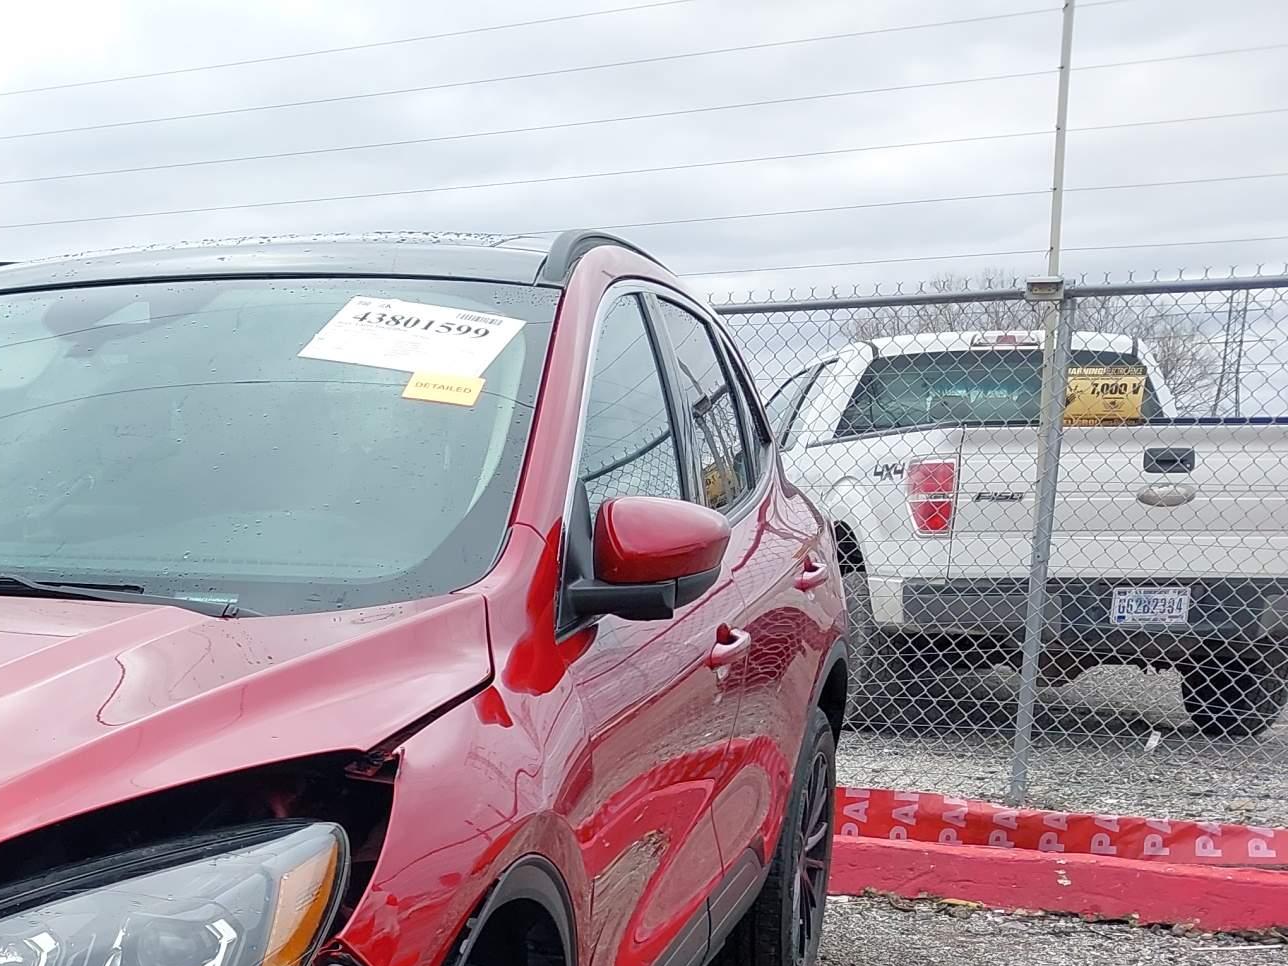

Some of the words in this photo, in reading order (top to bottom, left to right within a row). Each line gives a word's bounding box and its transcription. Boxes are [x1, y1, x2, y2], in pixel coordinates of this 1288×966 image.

[352, 311, 490, 339] 43801599
[414, 381, 472, 394] DETAILED
[1091, 383, 1127, 397] 7,000
